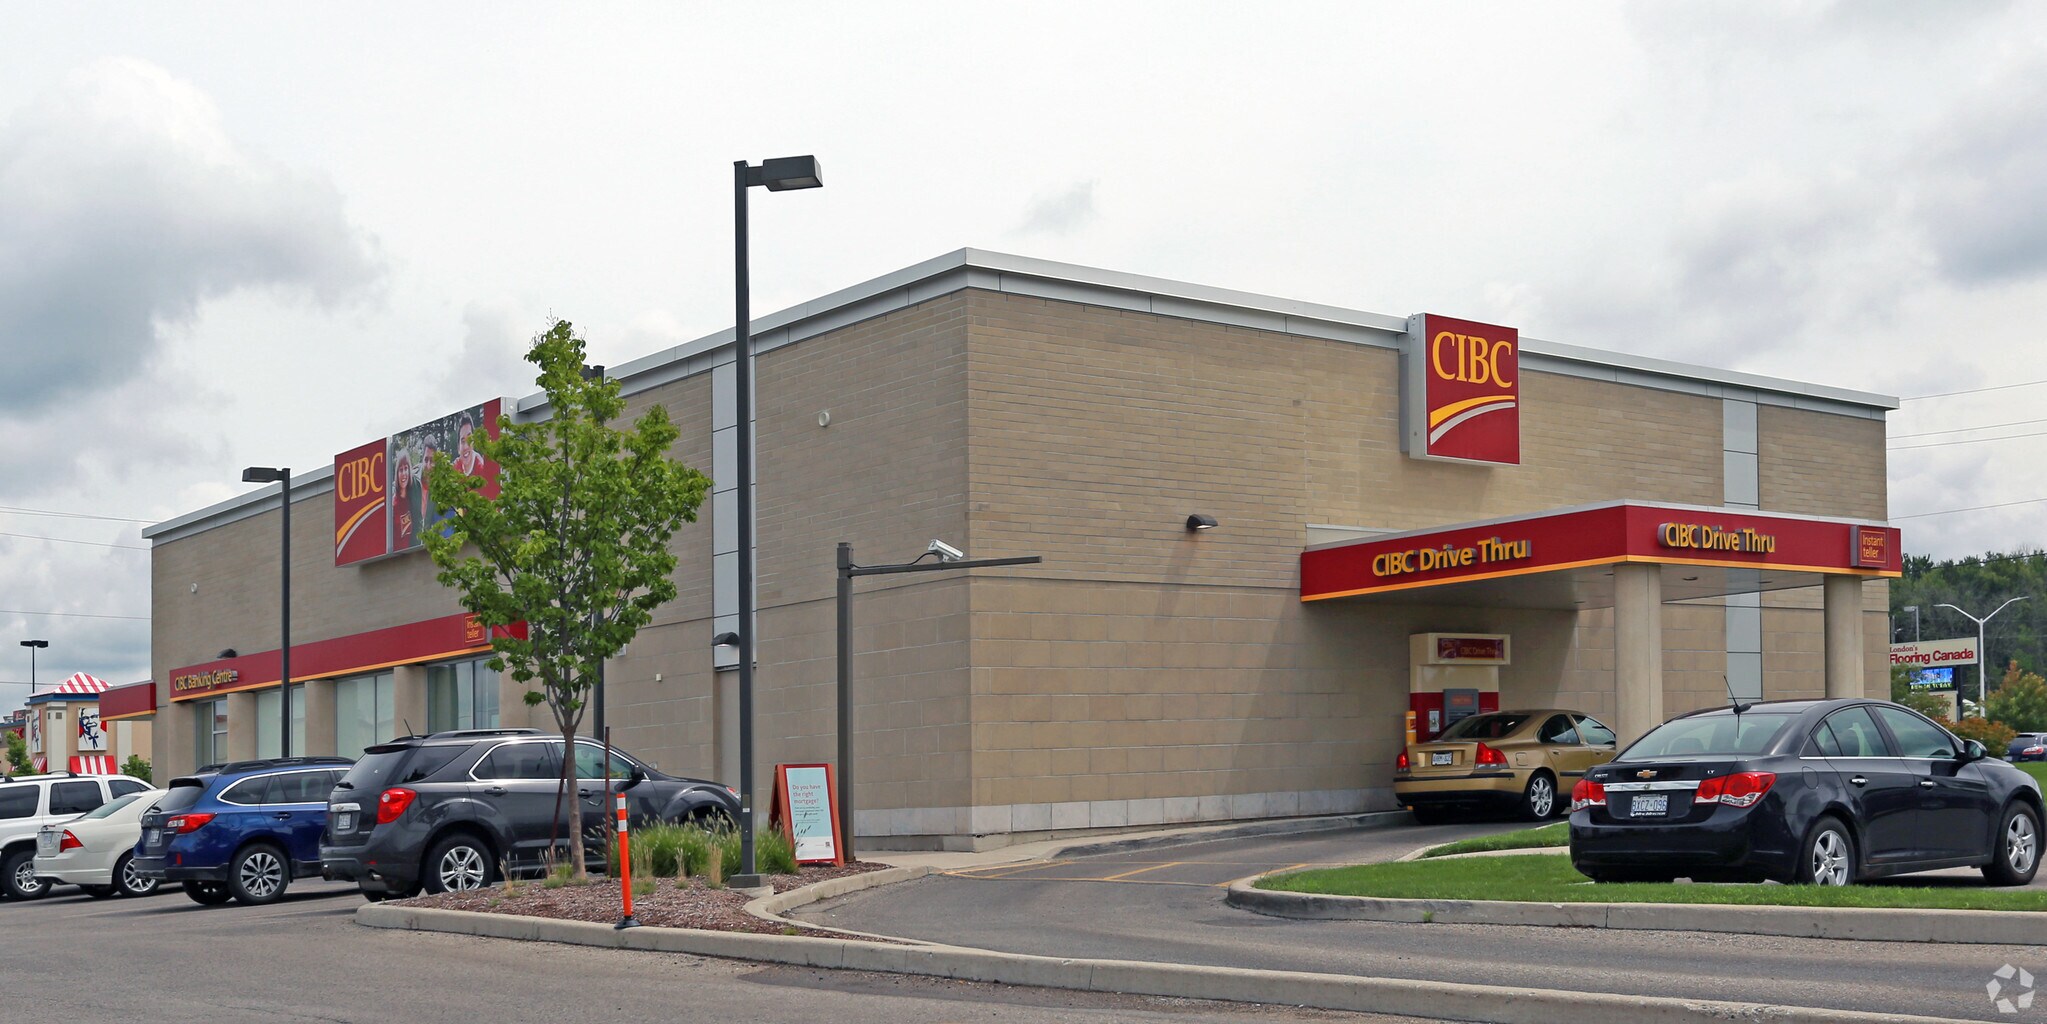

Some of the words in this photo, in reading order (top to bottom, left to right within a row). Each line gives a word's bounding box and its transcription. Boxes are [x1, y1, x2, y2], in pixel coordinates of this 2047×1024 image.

[1432, 331, 1513, 388] CIBC
[338, 452, 384, 502] CIBC
[1665, 522, 1700, 548] CIBC
[1702, 525, 1740, 551] Drive
[1742, 528, 1775, 553] Thru
[1862, 534, 1884, 547] Instant
[1372, 550, 1416, 576] CIBC
[1419, 543, 1476, 572] Drive
[1477, 536, 1529, 563] Thru
[1862, 546, 1879, 558] teller
[466, 629, 479, 639] teller
[1890, 645, 1918, 653] London's
[1890, 652, 1931, 664] Flooring
[1932, 649, 1974, 662] Canada
[175, 676, 188, 691] CIBC
[188, 673, 211, 690] Banking
[211, 669, 235, 685] Centre
